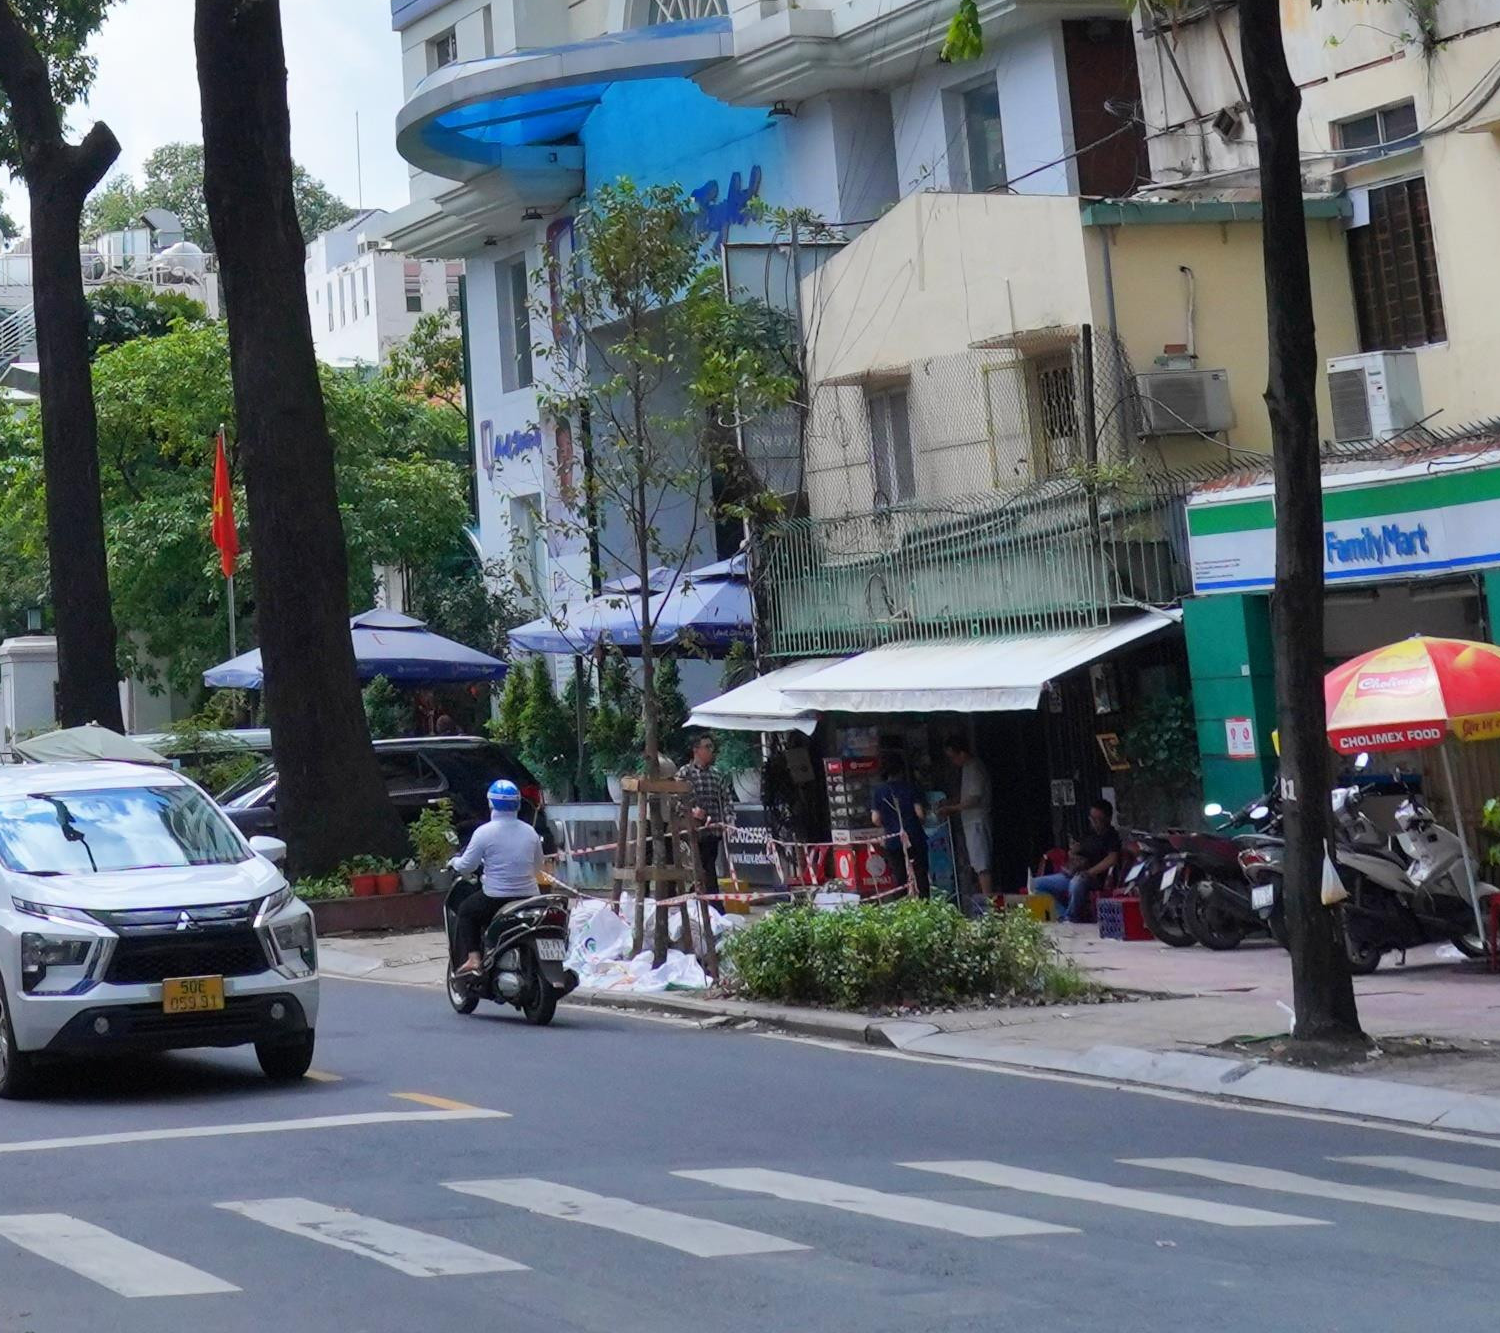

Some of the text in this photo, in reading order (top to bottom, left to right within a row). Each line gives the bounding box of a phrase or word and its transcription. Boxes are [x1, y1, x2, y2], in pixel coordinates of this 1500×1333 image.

[1325, 522, 1430, 565] FamilyMart
[1340, 729, 1441, 748] CHOLIMEX FOOD
